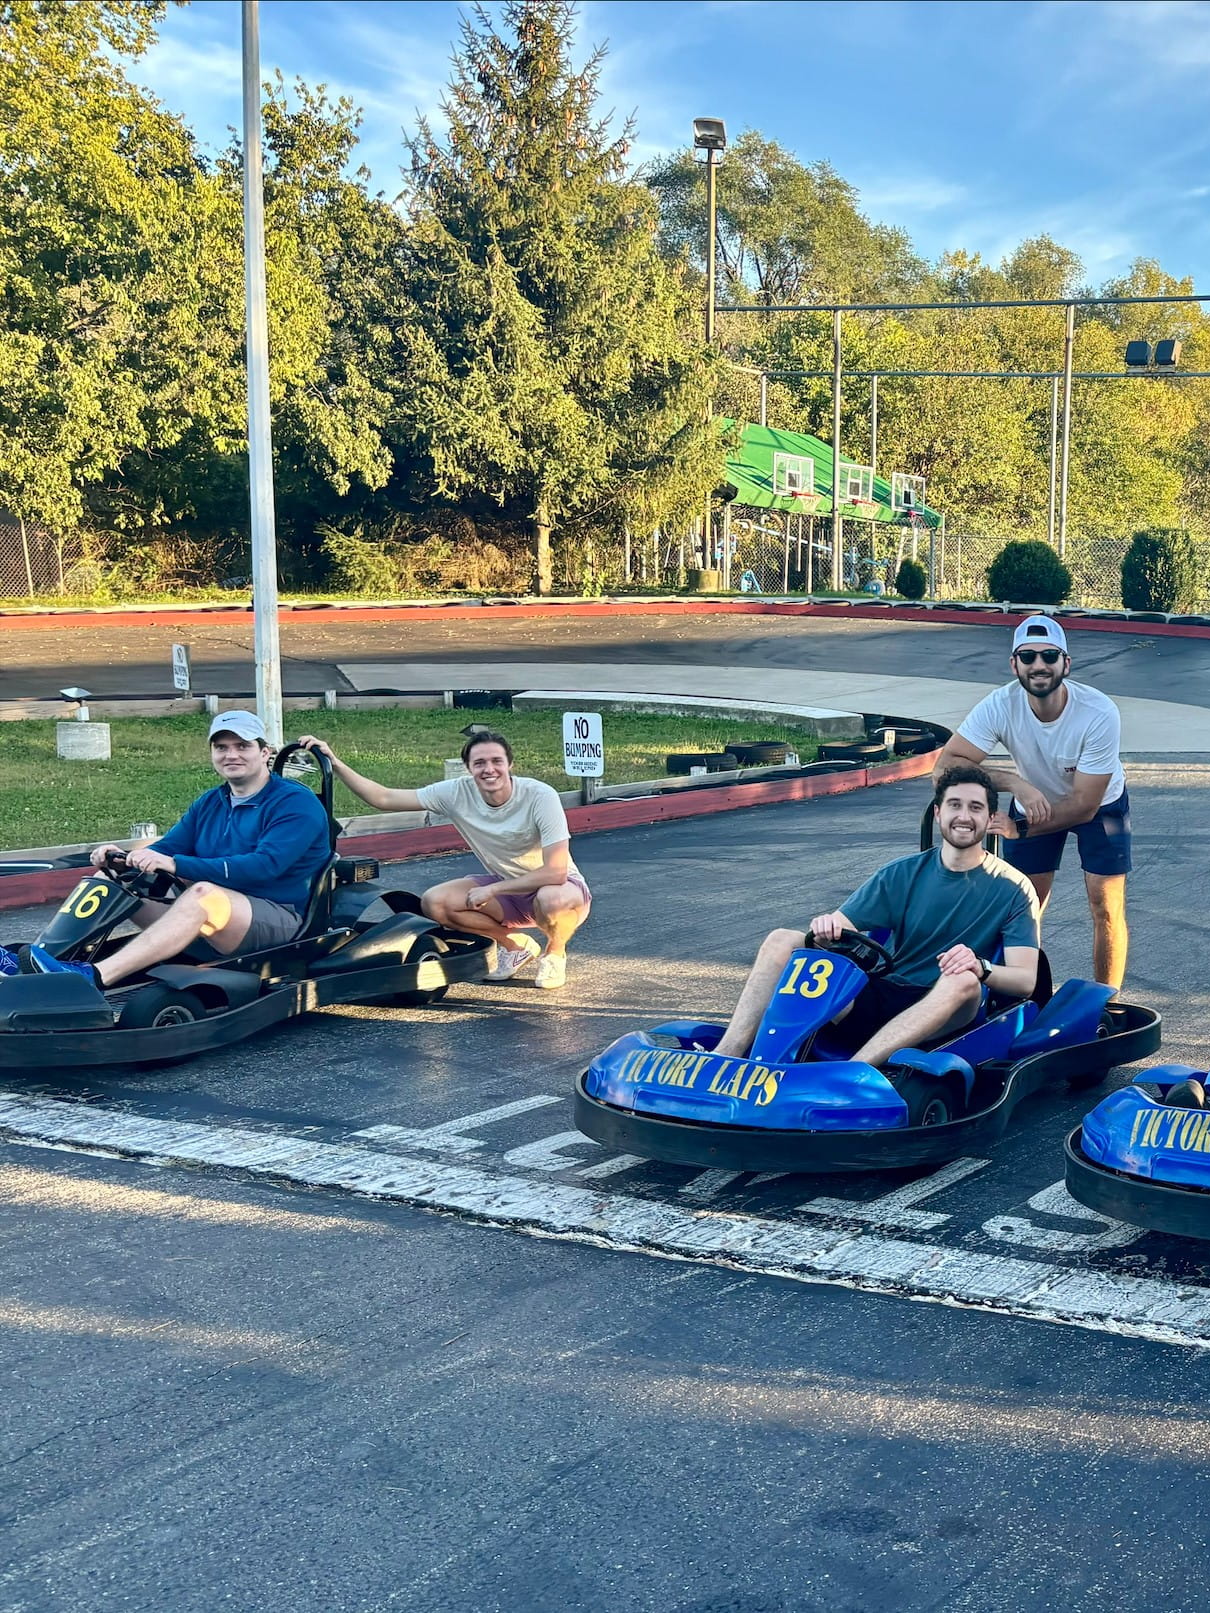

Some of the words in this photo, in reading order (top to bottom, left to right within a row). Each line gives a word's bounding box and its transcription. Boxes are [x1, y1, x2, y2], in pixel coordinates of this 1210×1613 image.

[574, 718, 589, 739] NO
[565, 742, 602, 758] BUMPING
[58, 881, 109, 919] 16
[778, 957, 834, 999] 13
[617, 1048, 711, 1090] VICTORY
[706, 1059, 785, 1107] LAPS
